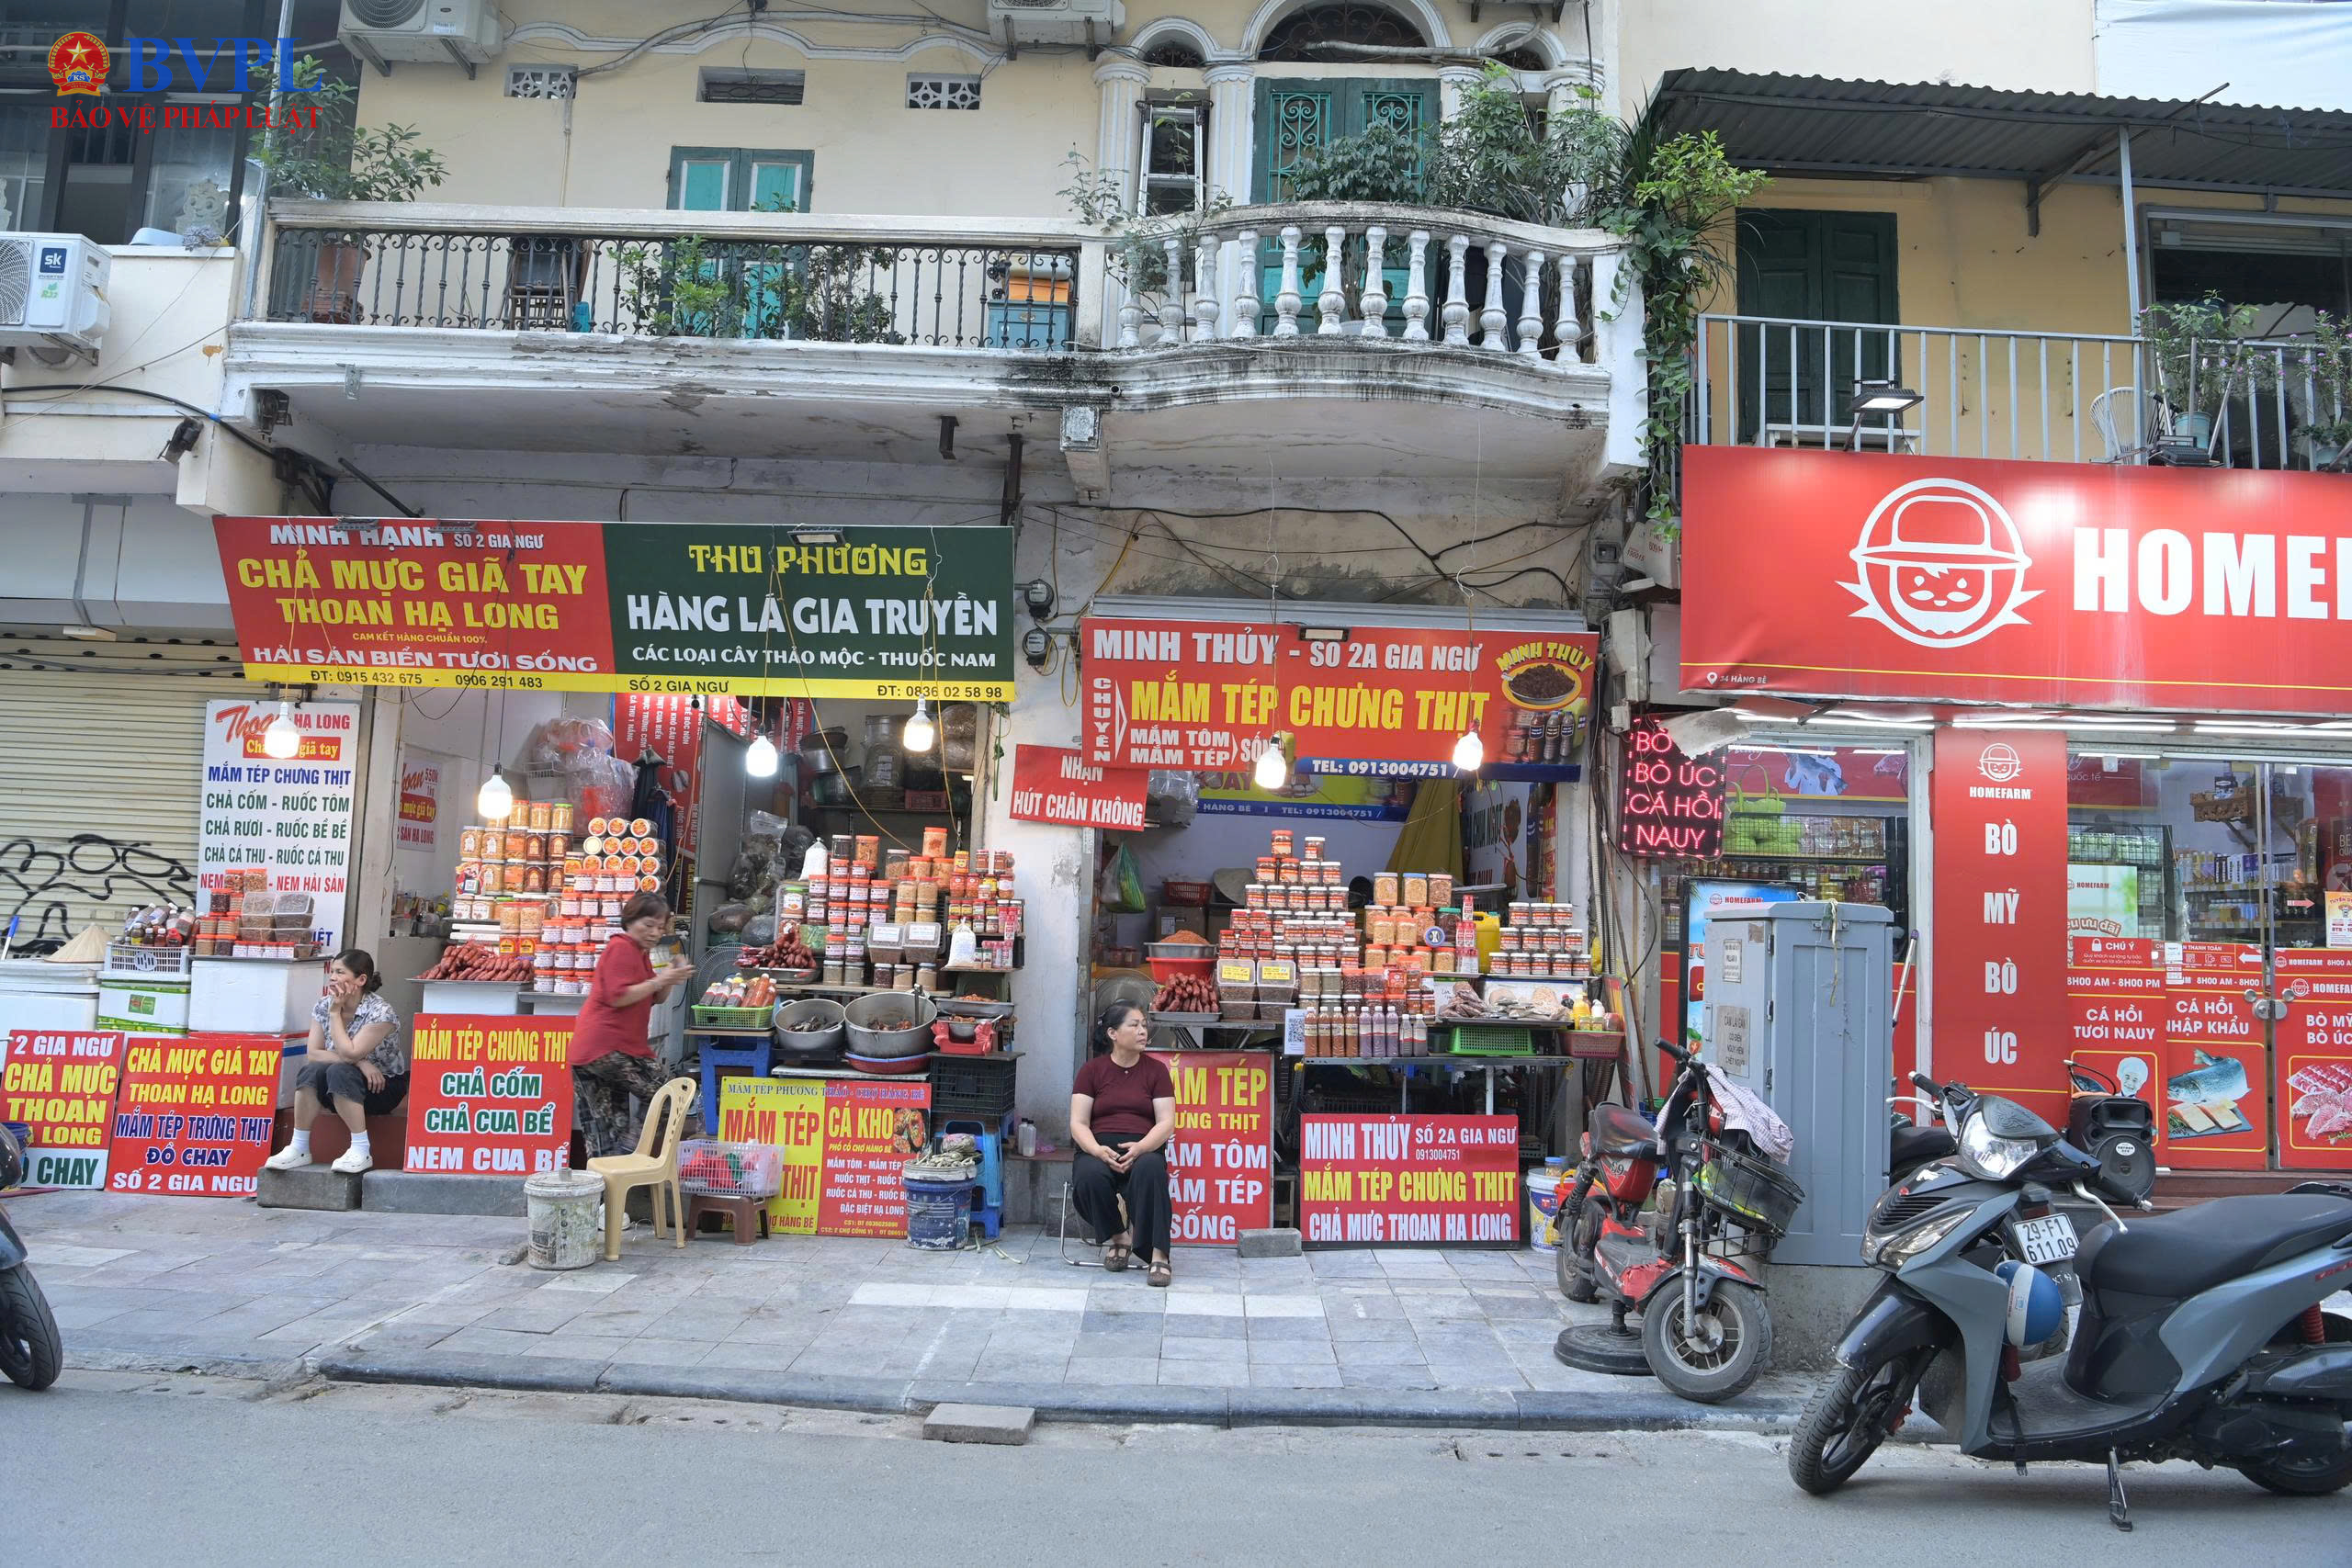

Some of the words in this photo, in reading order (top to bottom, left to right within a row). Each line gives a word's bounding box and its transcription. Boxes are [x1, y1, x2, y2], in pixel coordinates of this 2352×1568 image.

[45, 254, 62, 265] sk
[270, 525, 350, 545] MINH
[360, 526, 444, 551] HẠNH
[776, 543, 927, 575] PHƯƠNG
[331, 558, 424, 596] MỰC
[438, 557, 509, 592] GIÃ
[519, 564, 587, 594] TAY
[276, 598, 393, 626] THOAN
[404, 601, 453, 632] HẠ
[463, 602, 560, 629] LONG
[628, 591, 729, 632] HÀNG
[793, 596, 859, 634] GIA
[865, 592, 997, 636] TRUYỀN
[353, 632, 375, 640] CAM
[377, 631, 394, 641] KẾT
[1093, 629, 1181, 661] MINH
[1192, 626, 1279, 665] THỦY
[254, 645, 301, 662] HẢI
[307, 647, 365, 664] SẢN
[370, 646, 434, 666] BIỂN
[438, 651, 510, 669] TƯƠI
[516, 649, 597, 671] SỐNG
[632, 644, 669, 661] CÁC
[674, 648, 716, 665] LOẠI
[720, 646, 758, 662] CÂY
[763, 646, 815, 664] THẢO
[820, 648, 864, 669] MỘC
[879, 647, 945, 667] THUỐC
[951, 653, 995, 667] NAM
[1496, 641, 1543, 672] MINH
[1547, 641, 1593, 672] THỦY
[311, 671, 333, 681] ĐT:
[338, 671, 368, 682] 0915
[372, 672, 394, 682] 432
[400, 673, 422, 684] 675
[456, 675, 486, 685] 0906
[492, 676, 514, 686] 291
[519, 677, 542, 688] 483
[629, 676, 650, 691] SỐ
[654, 681, 662, 691] 2
[667, 682, 692, 692] GIA
[696, 681, 729, 693] NGƯ
[877, 685, 900, 696] ĐT:
[906, 686, 938, 697] 0836
[944, 686, 959, 697] 02
[965, 687, 980, 697] 58
[986, 687, 1001, 698] 98
[1131, 670, 1210, 723] MẮM
[1222, 678, 1278, 725] TÉP
[1290, 682, 1404, 730] CHƯNG
[1415, 691, 1490, 739] THỊT
[1130, 725, 1179, 746] MẮM
[1186, 728, 1230, 748] TÔM
[1130, 745, 1183, 764] MẮM
[1191, 749, 1229, 766] TÉP
[1312, 760, 1343, 773] TEL:
[1349, 761, 1447, 776] 0913004751
[209, 761, 242, 782] MẮM
[247, 764, 269, 783] TÉP
[275, 767, 319, 784] CHƯNG
[323, 770, 351, 788] THỊT
[1634, 759, 1671, 784] BÒ
[1679, 761, 1716, 787] ÚC
[1629, 790, 1668, 816] CÁ
[1675, 790, 1719, 819] HỒI
[1969, 786, 2031, 800] HOMEFARM
[1012, 787, 1043, 816] HÚT
[1046, 792, 1088, 820] CHÂN
[1091, 795, 1143, 826] KHÔNG
[1637, 825, 1705, 849] NAUY
[1984, 818, 2018, 856] BÒ
[204, 842, 225, 863] CHẢ
[229, 844, 242, 863] CÁ
[246, 848, 265, 863] THU
[277, 844, 304, 864] RUỐC
[308, 847, 321, 865] CÁ
[324, 851, 344, 866] THU
[277, 875, 300, 891] NEM
[303, 872, 321, 892] HẢI
[323, 873, 345, 893] SẢN
[1984, 887, 2019, 925] MỸ
[2106, 942, 2126, 950] CHÚ
[2129, 942, 2134, 951] Ý
[1984, 957, 2018, 995] BÒ
[2094, 977, 2109, 987] AM
[2119, 979, 2143, 987] 8H00
[2146, 979, 2160, 987] PM
[2086, 1006, 2109, 1022] CÁ
[2115, 1003, 2143, 1022] HỒI
[2074, 1025, 2109, 1039] TƯƠI
[2114, 1028, 2155, 1040] NAUY
[14, 1035, 28, 1055] 2
[33, 1036, 66, 1055] GIA
[73, 1035, 116, 1056] NGƯ
[1984, 1026, 2017, 1065] ÚC
[5, 1057, 52, 1092] CHẢ
[61, 1061, 117, 1099] MỰC
[441, 1066, 487, 1099] CHẢ
[491, 1066, 542, 1099] CỐM
[130, 1083, 187, 1103] THOAN
[191, 1085, 215, 1108] HẠ
[220, 1086, 268, 1105] LONG
[7, 1098, 107, 1123] THOAN
[425, 1102, 471, 1134] CHẢ
[475, 1109, 517, 1134] CUA
[522, 1102, 556, 1135] BỂ
[784, 1104, 820, 1146] TÉP
[829, 1100, 854, 1138] CÁ
[857, 1107, 893, 1140] KHO
[42, 1126, 102, 1145] LONG
[115, 1105, 153, 1138] MẮM
[157, 1111, 184, 1139] TÉP
[187, 1114, 236, 1141] TRƯNG
[240, 1117, 272, 1146] THỊT
[1305, 1123, 1355, 1159] MINH
[1361, 1115, 1410, 1161] THỦY
[1415, 1122, 1434, 1145] SỐ
[1438, 1128, 1455, 1144] 2A
[1460, 1128, 1484, 1144] GIA
[1488, 1126, 1516, 1145] NGƯ
[146, 1143, 175, 1165] ĐỒ
[181, 1147, 232, 1167] CHAY
[1415, 1149, 1460, 1161] 0913004751
[37, 1156, 98, 1185] CHAY
[1304, 1162, 1351, 1201] MẮM
[1358, 1167, 1393, 1201] TÉP
[1398, 1168, 1466, 1202] CHƯNG
[1473, 1171, 1516, 1207] THỊT
[886, 1206, 904, 1215] LONG
[2023, 1218, 2064, 1242] 29-F1
